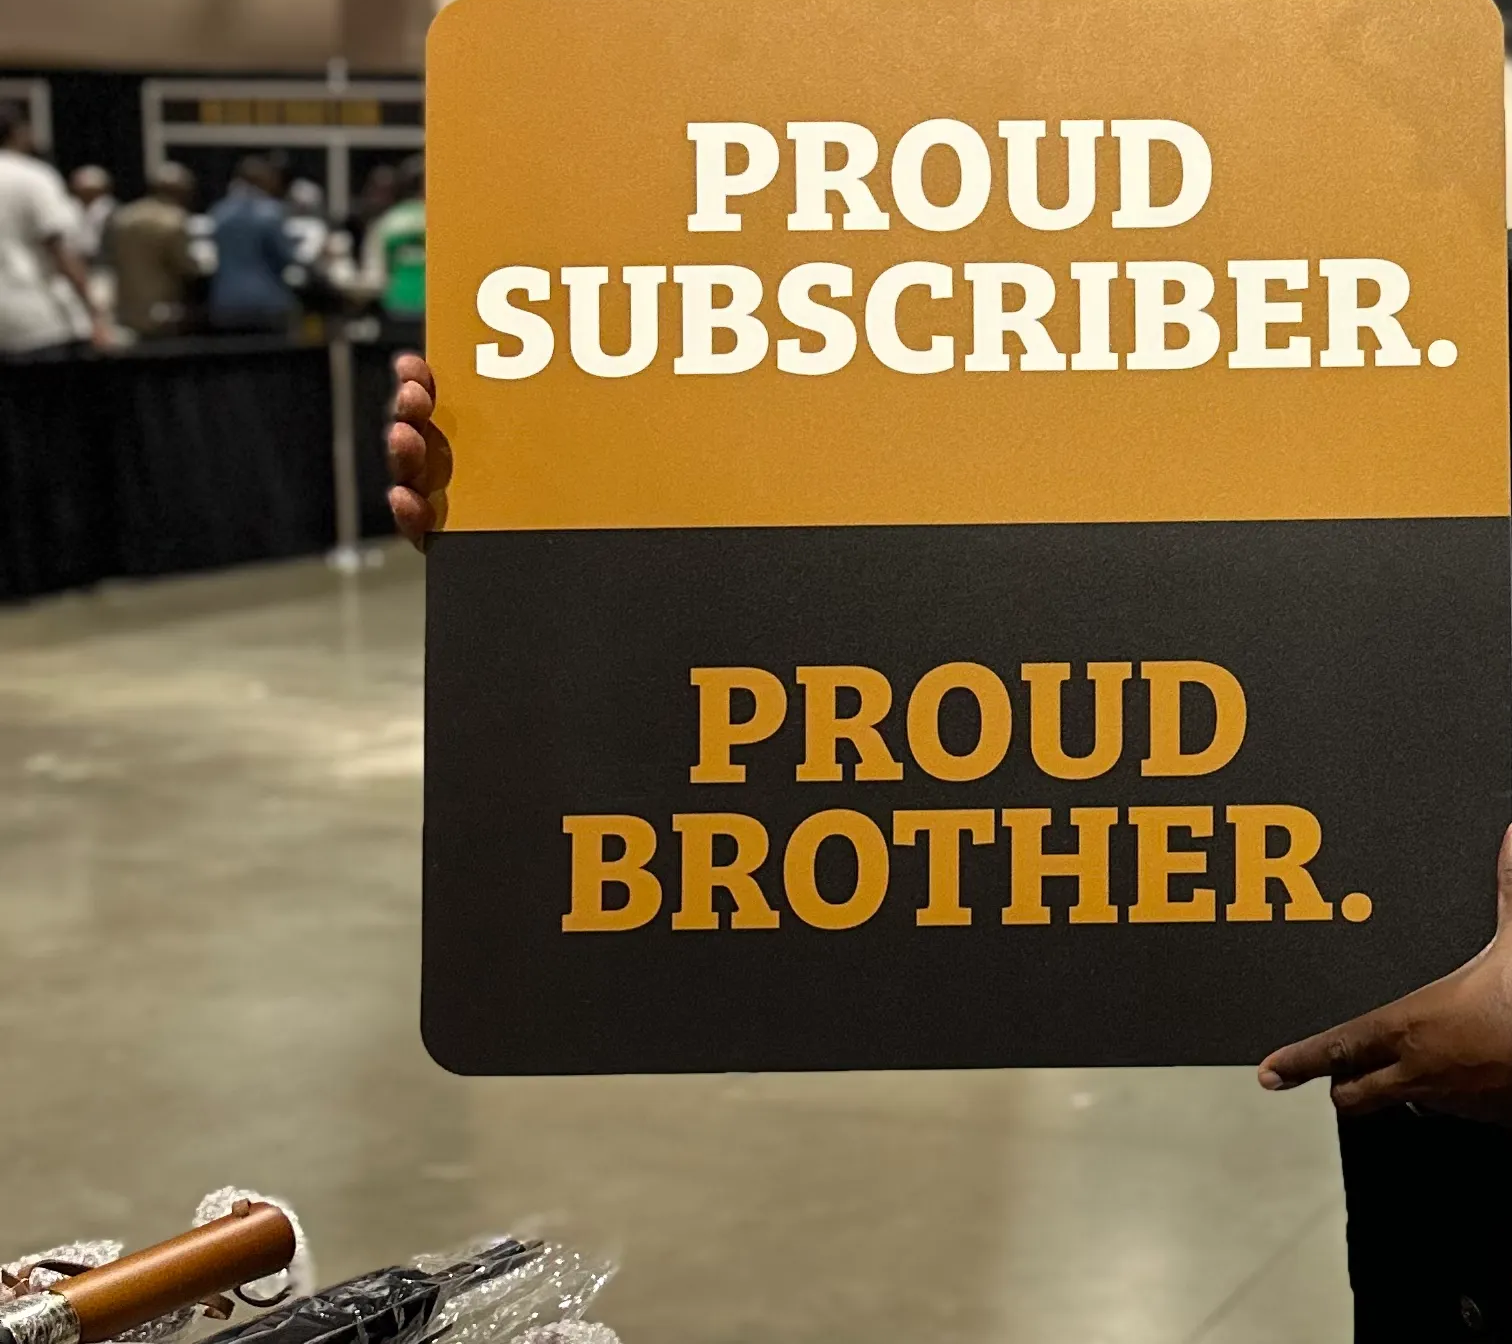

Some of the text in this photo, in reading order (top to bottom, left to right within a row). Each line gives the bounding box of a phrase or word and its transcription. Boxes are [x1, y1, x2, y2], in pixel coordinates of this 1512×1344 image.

[686, 117, 1213, 232] PROUD
[475, 258, 1459, 380] SUBSCRIBER.
[689, 660, 1248, 784] PROUD
[561, 803, 1374, 933] BROTHER.
